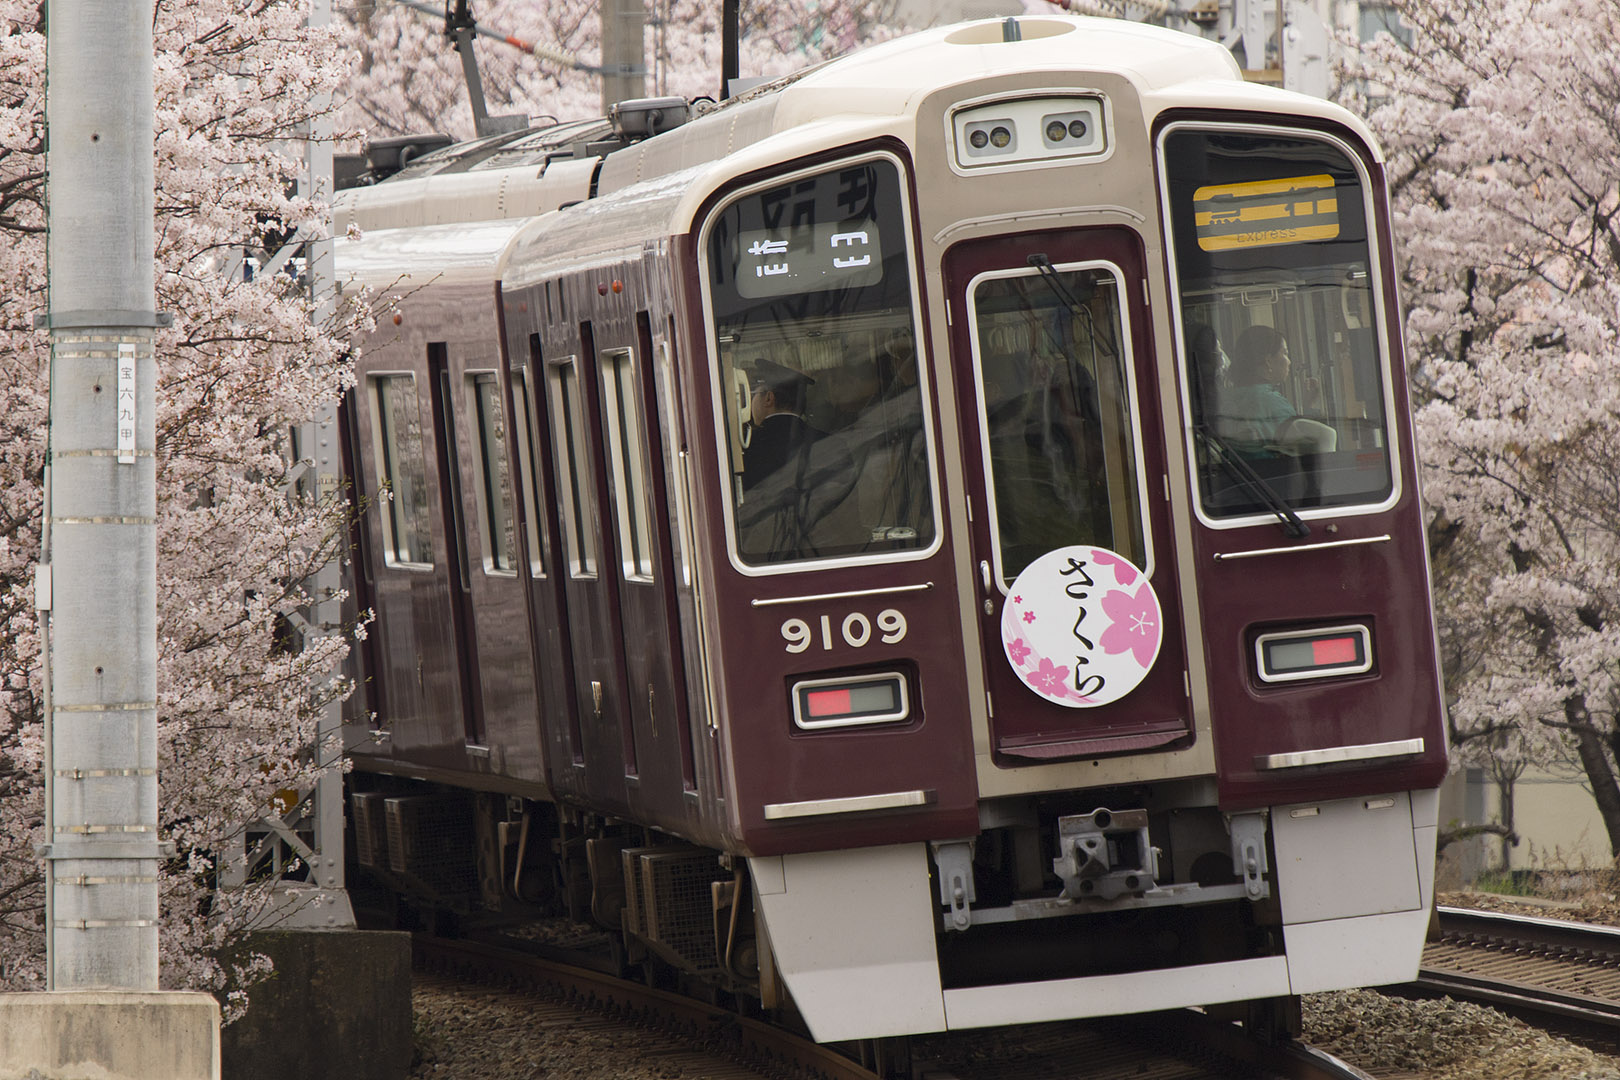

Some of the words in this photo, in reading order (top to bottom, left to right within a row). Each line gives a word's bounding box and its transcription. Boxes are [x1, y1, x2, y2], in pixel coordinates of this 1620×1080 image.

[1237, 228, 1297, 242] Express
[120, 367, 133, 440] 宝六九甲
[780, 608, 908, 654] 9109
[1059, 557, 1106, 699] さくら
